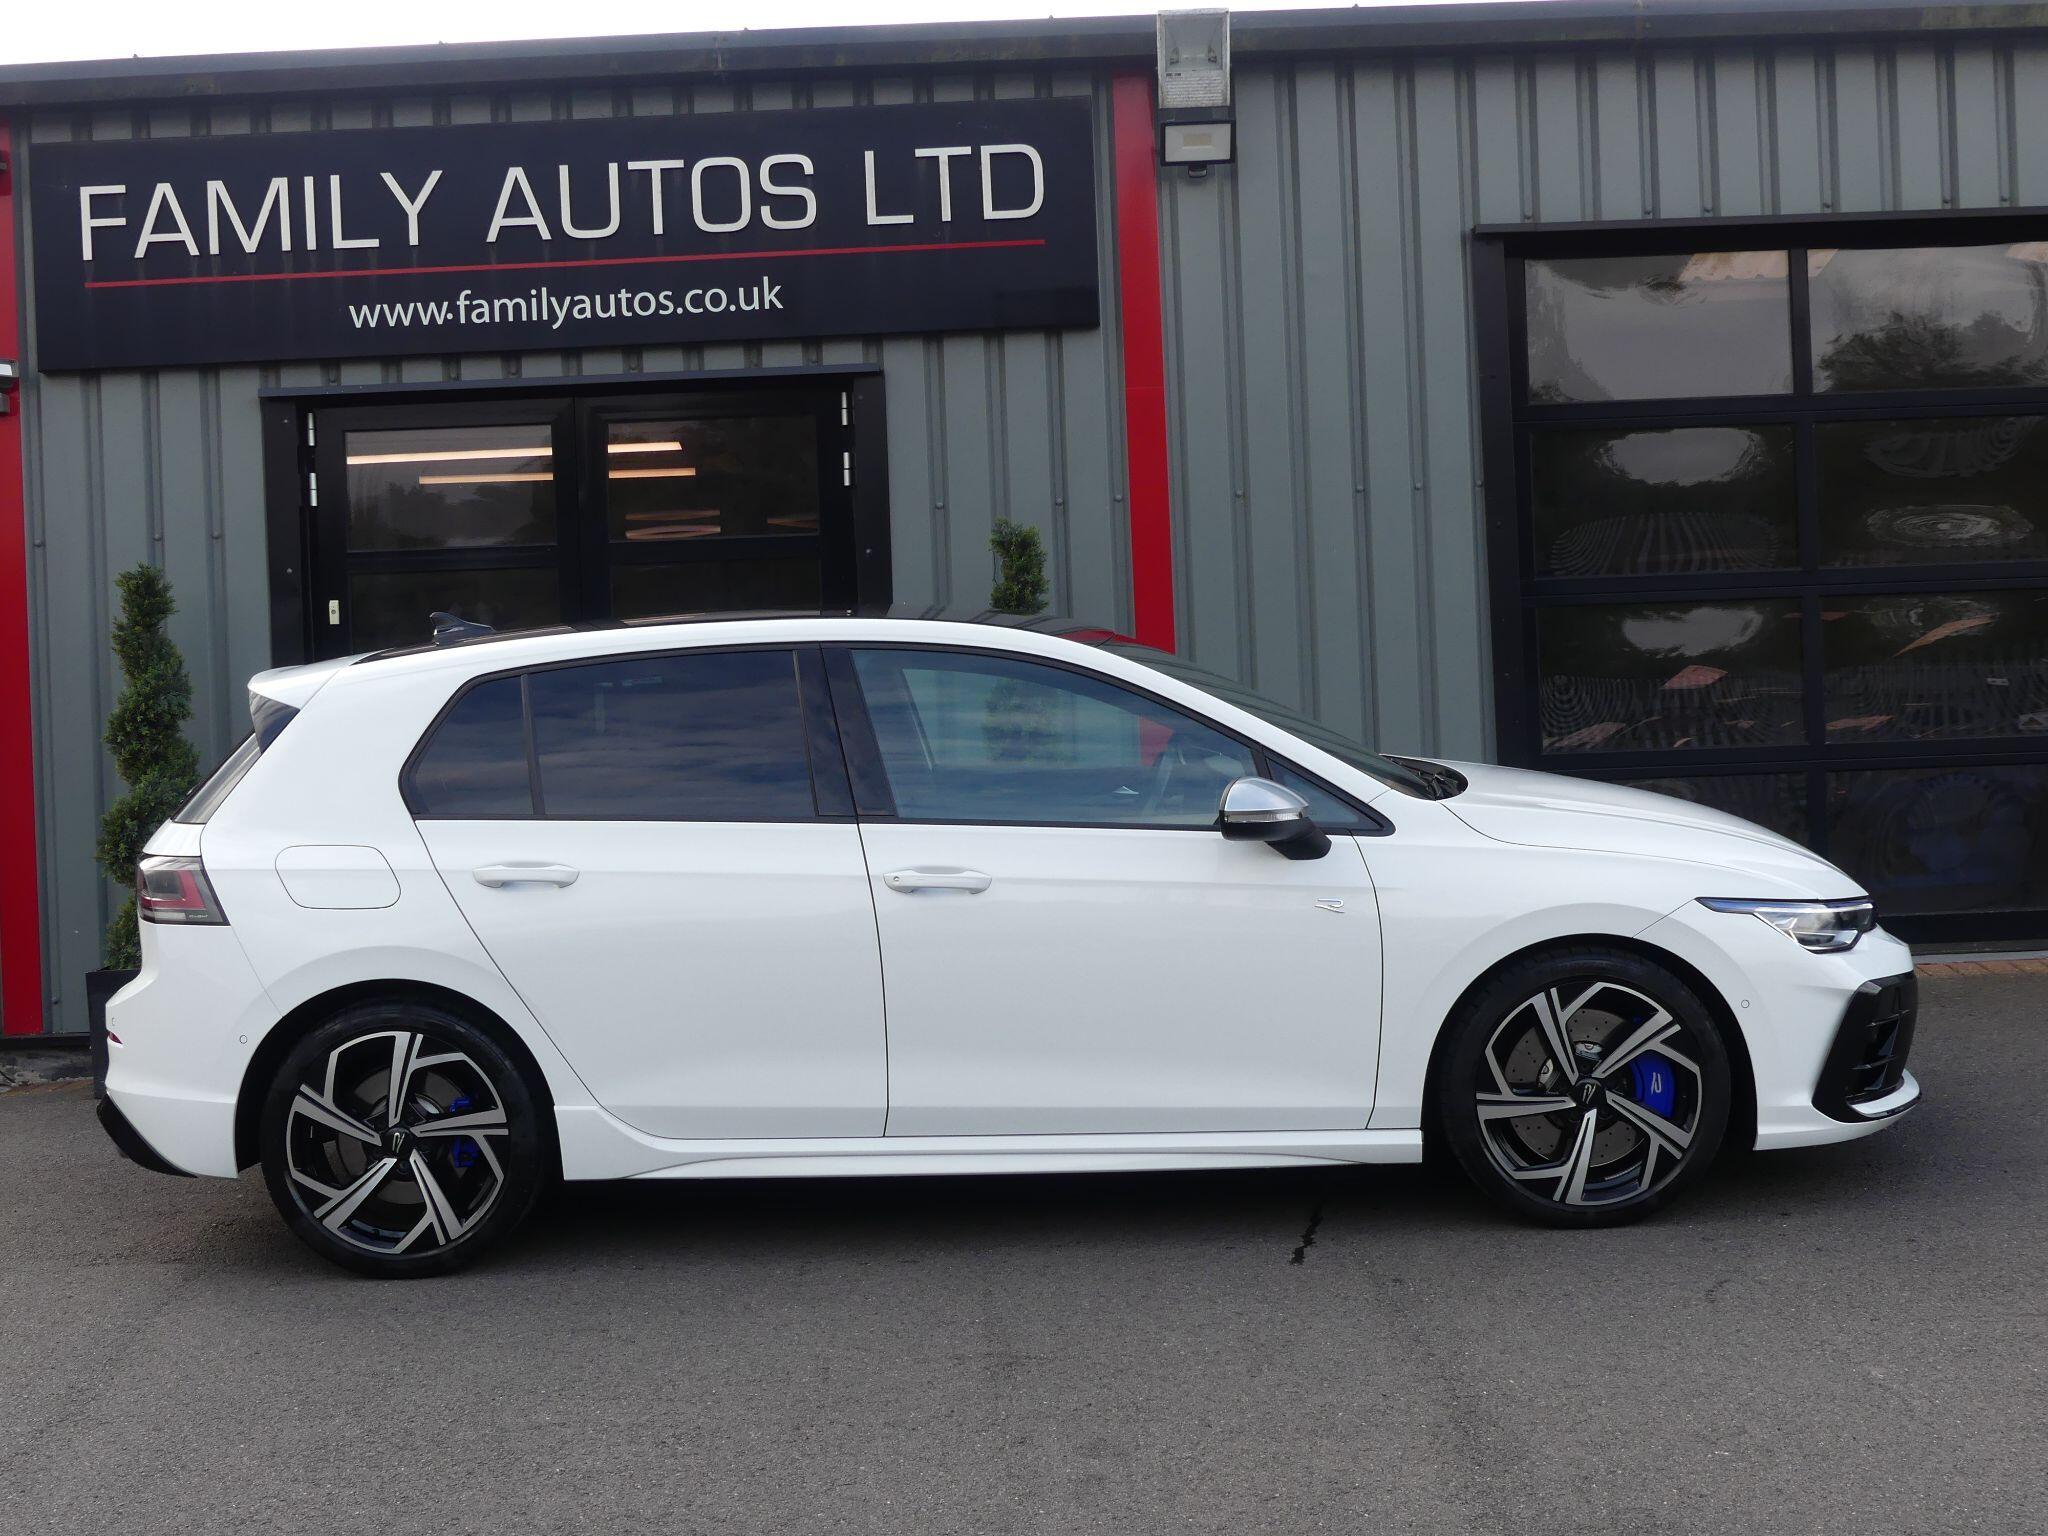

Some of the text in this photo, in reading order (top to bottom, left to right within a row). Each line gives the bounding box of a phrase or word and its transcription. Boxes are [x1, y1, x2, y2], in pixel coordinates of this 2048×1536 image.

[79, 143, 1046, 261] FAMILY AUTOS LTD
[348, 275, 784, 330] www.familyautos.co.uk
